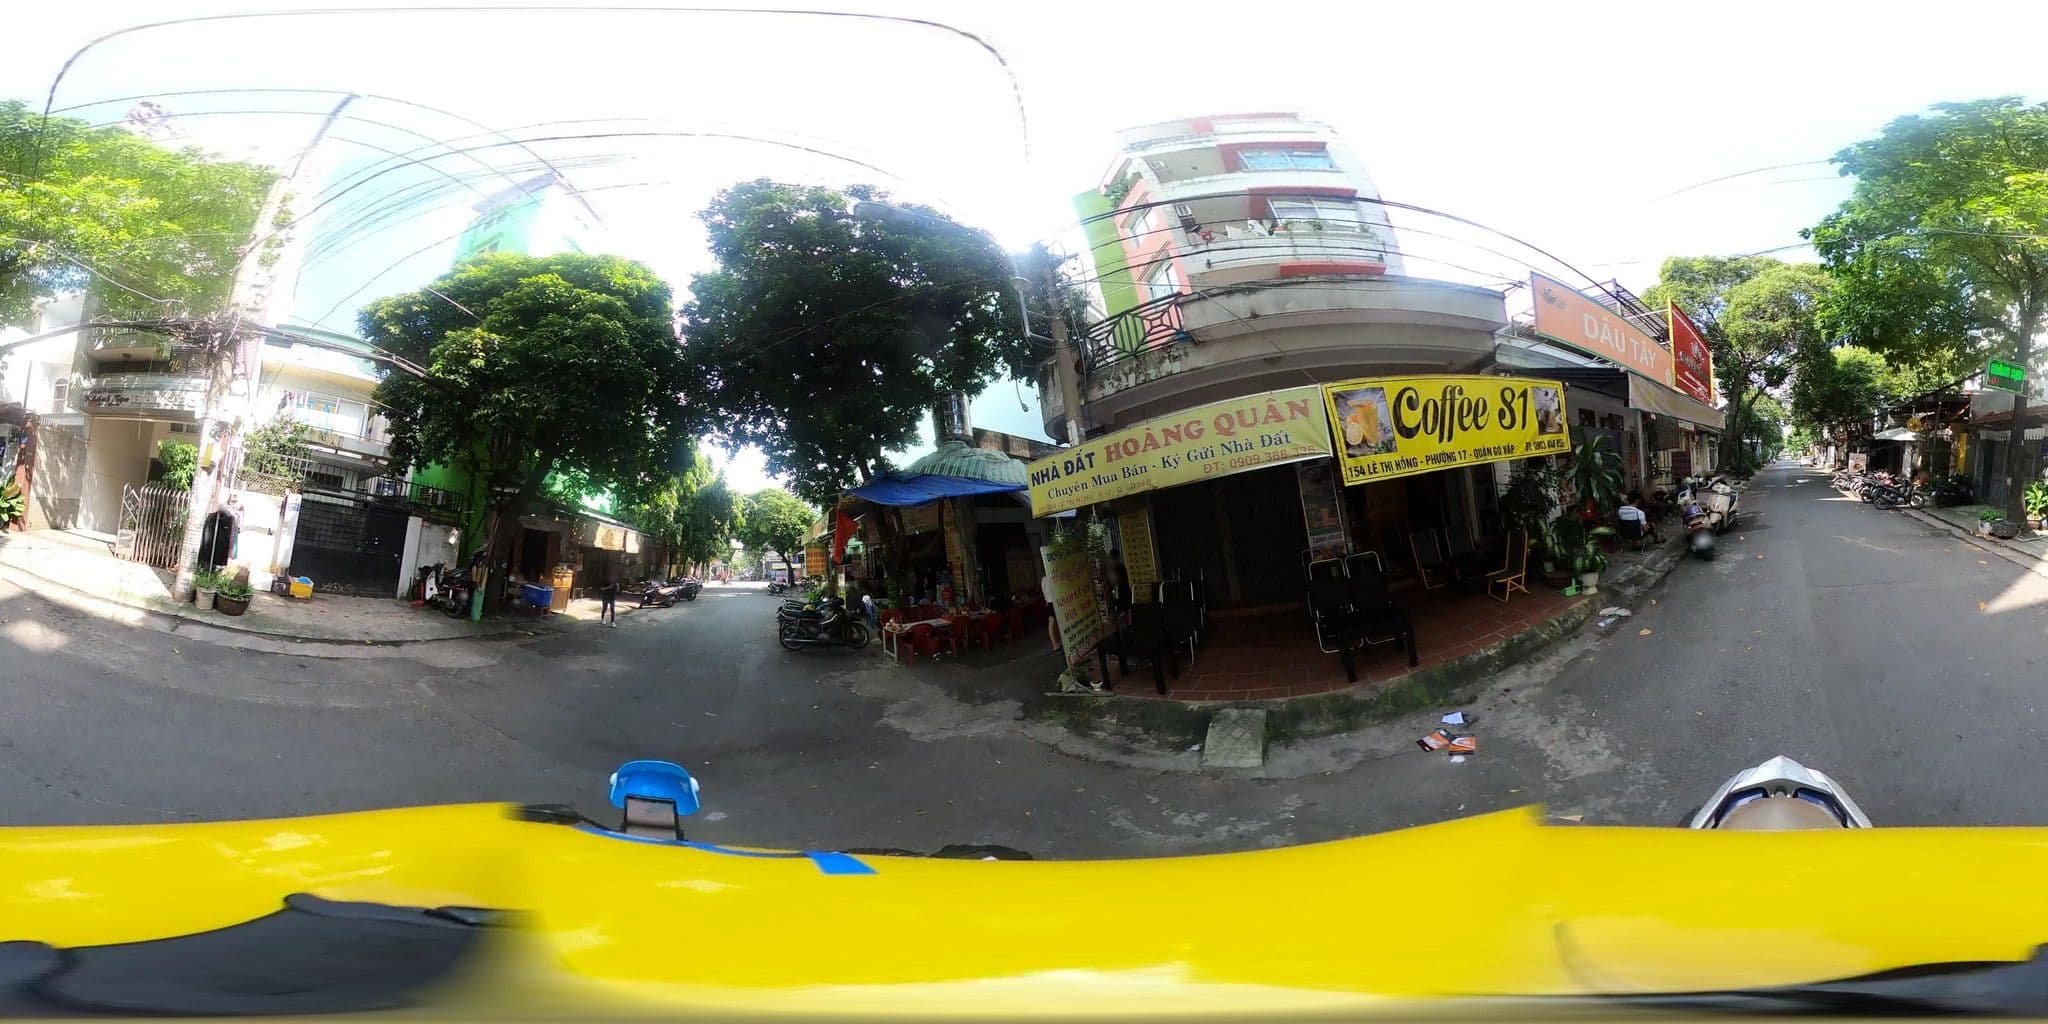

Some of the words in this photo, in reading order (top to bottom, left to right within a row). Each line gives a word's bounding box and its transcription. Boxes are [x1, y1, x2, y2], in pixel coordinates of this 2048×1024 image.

[1583, 312, 1625, 353] DÂU
[1393, 385, 1489, 444] Coffee
[1031, 462, 1060, 487] NHÀ
[1064, 449, 1095, 476] ĐẤT
[1104, 419, 1206, 464] HOÀNG
[1213, 398, 1311, 436] QUÂN
[1047, 480, 1088, 500] Chuyên
[1092, 472, 1118, 487] Mua
[1122, 465, 1148, 479] Bán
[1161, 455, 1181, 471] Ký
[1186, 446, 1215, 464] Gửi
[1221, 439, 1254, 455] Nhà
[1259, 429, 1292, 446] Đất
[1349, 466, 1365, 478] 154
[1458, 450, 1467, 461] 17
[1203, 462, 1226, 474] ĐT:
